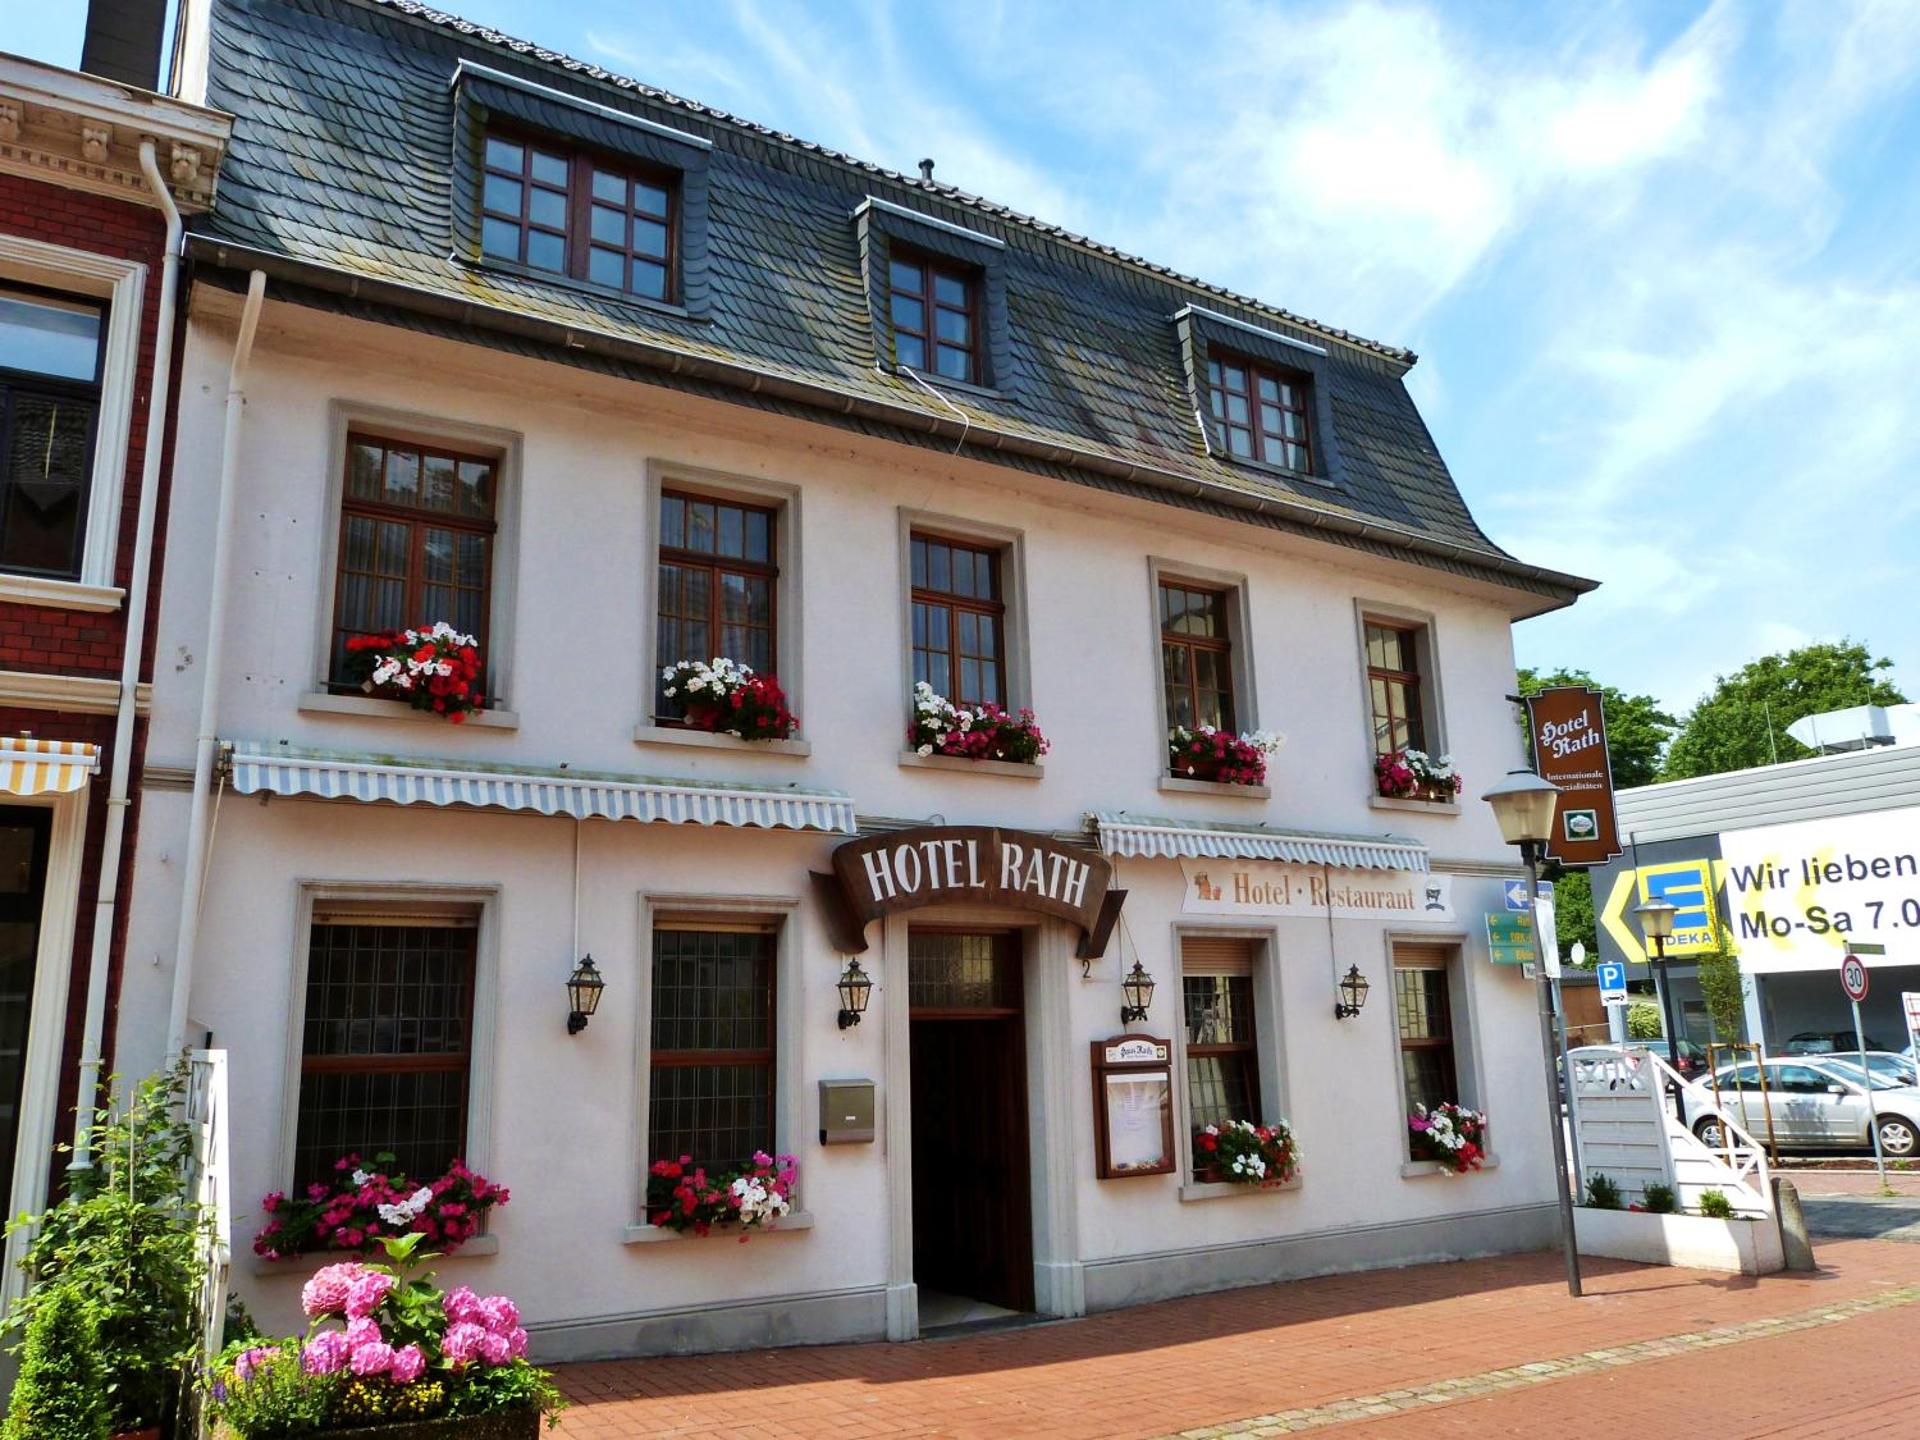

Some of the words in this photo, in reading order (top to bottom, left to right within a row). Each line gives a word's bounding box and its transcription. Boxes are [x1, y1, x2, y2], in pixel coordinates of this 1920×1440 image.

[1540, 708, 1588, 746] Hotel
[1552, 728, 1600, 758] Rath
[1546, 770, 1604, 781] Internationale
[861, 839, 988, 902] HOTEL
[1000, 842, 1090, 908] RATH
[1731, 862, 1790, 892] Wir
[1802, 853, 1918, 886] lieben
[1232, 872, 1291, 905] Hotel
[1309, 876, 1415, 911] Restaurant
[1740, 905, 1853, 939] Mo-Sa
[1660, 931, 1713, 946] DEKA
[1082, 959, 1091, 978] 2
[1603, 967, 1618, 988] P
[1846, 967, 1862, 988] 30
